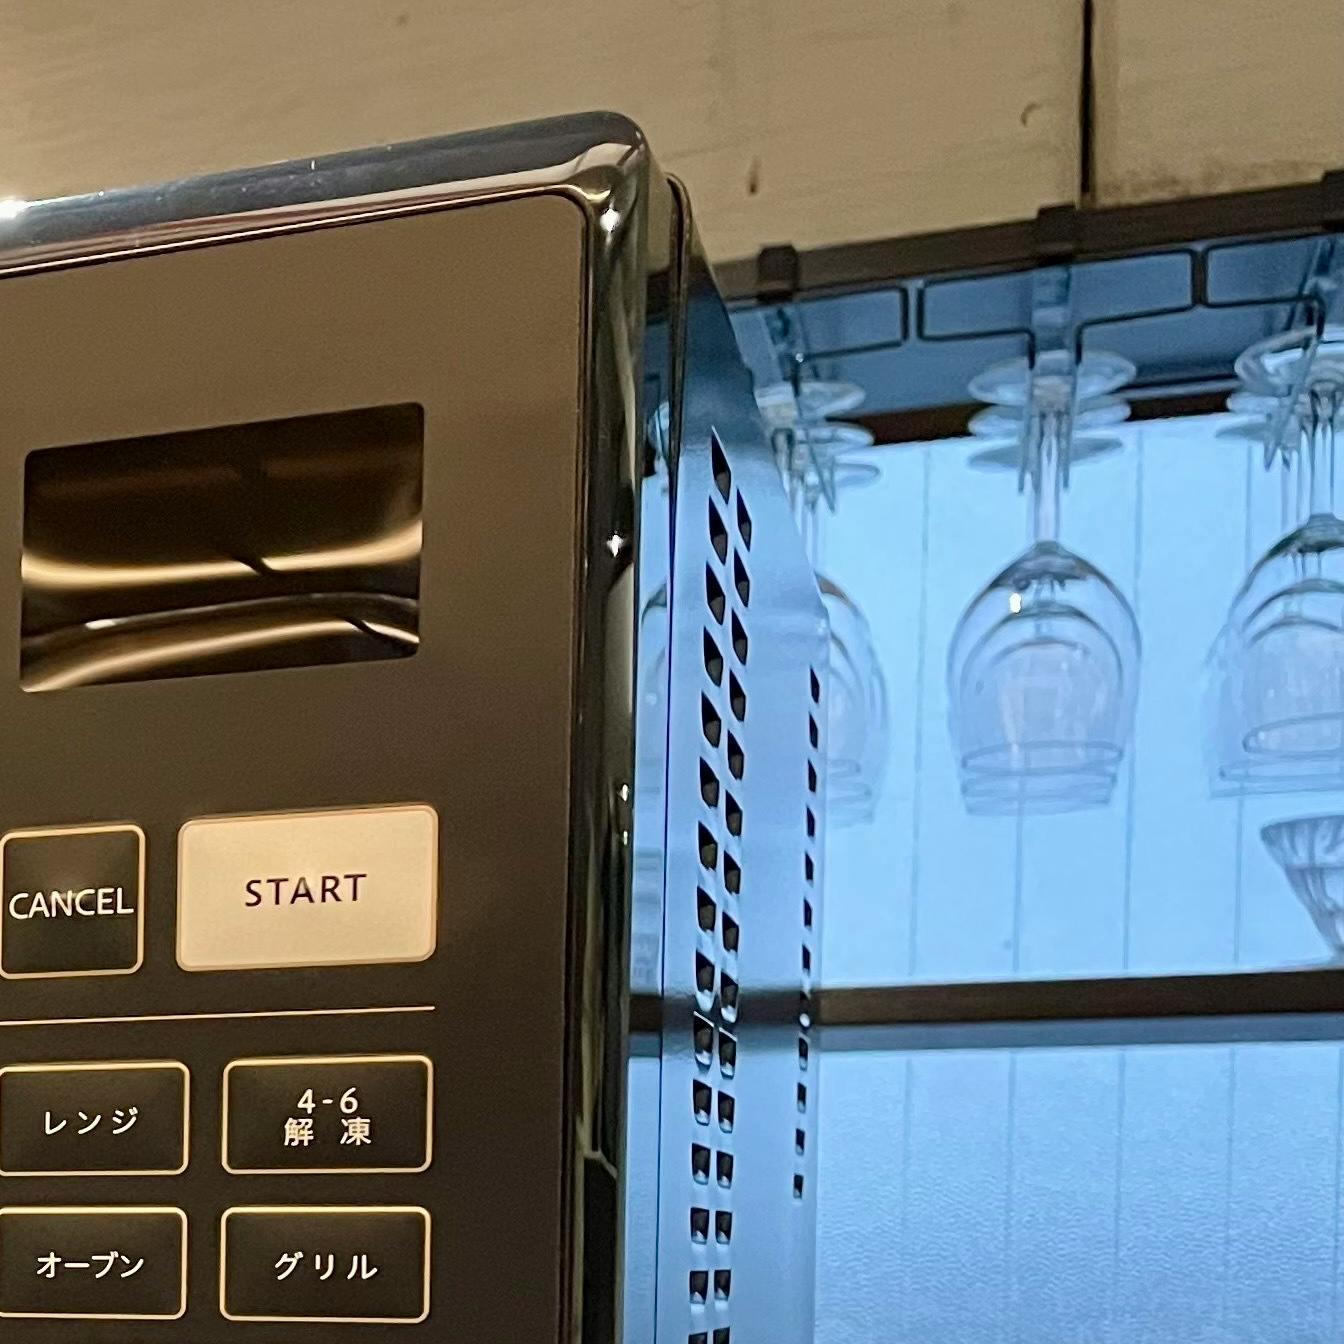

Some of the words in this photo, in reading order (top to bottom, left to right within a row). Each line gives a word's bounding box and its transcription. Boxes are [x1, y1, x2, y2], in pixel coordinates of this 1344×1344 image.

[8, 886, 134, 920] CANCEL
[244, 873, 368, 907] START
[297, 1087, 359, 1114] 4-6
[43, 1105, 139, 1136] レンジ
[283, 1117, 372, 1146] 解凍
[36, 1250, 145, 1279] オーブン
[273, 1250, 378, 1281] グリル
